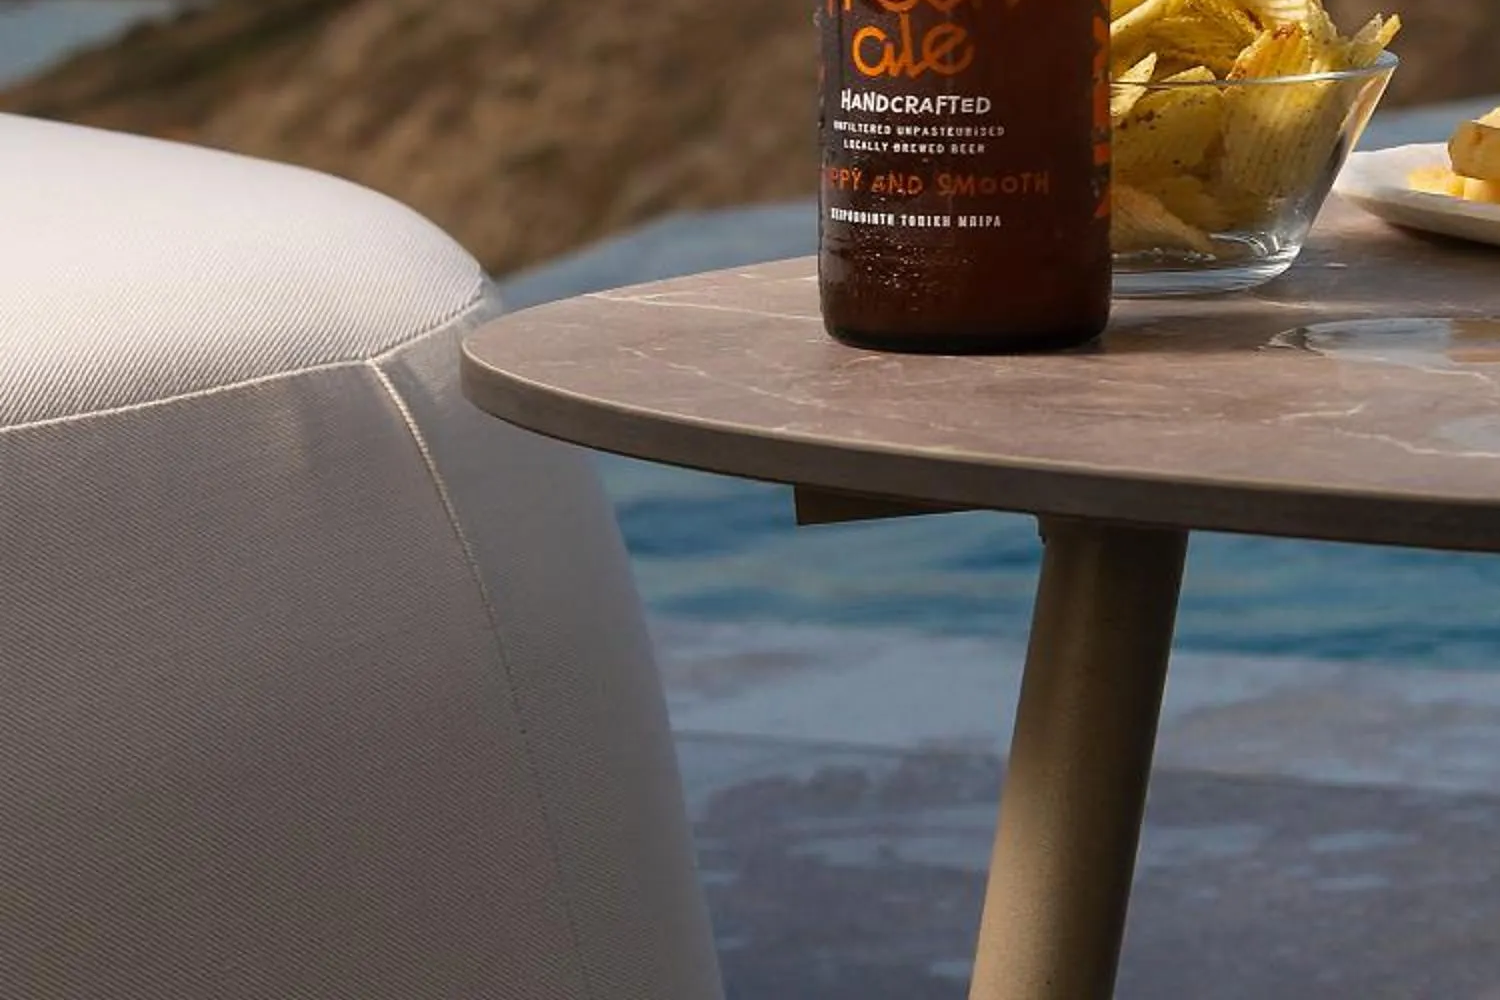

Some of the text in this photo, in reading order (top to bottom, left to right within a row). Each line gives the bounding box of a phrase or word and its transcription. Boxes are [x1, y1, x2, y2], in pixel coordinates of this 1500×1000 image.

[852, 11, 974, 79] ale
[840, 88, 992, 115] HANDCRAFTED
[936, 171, 1050, 197] SMOOTH
